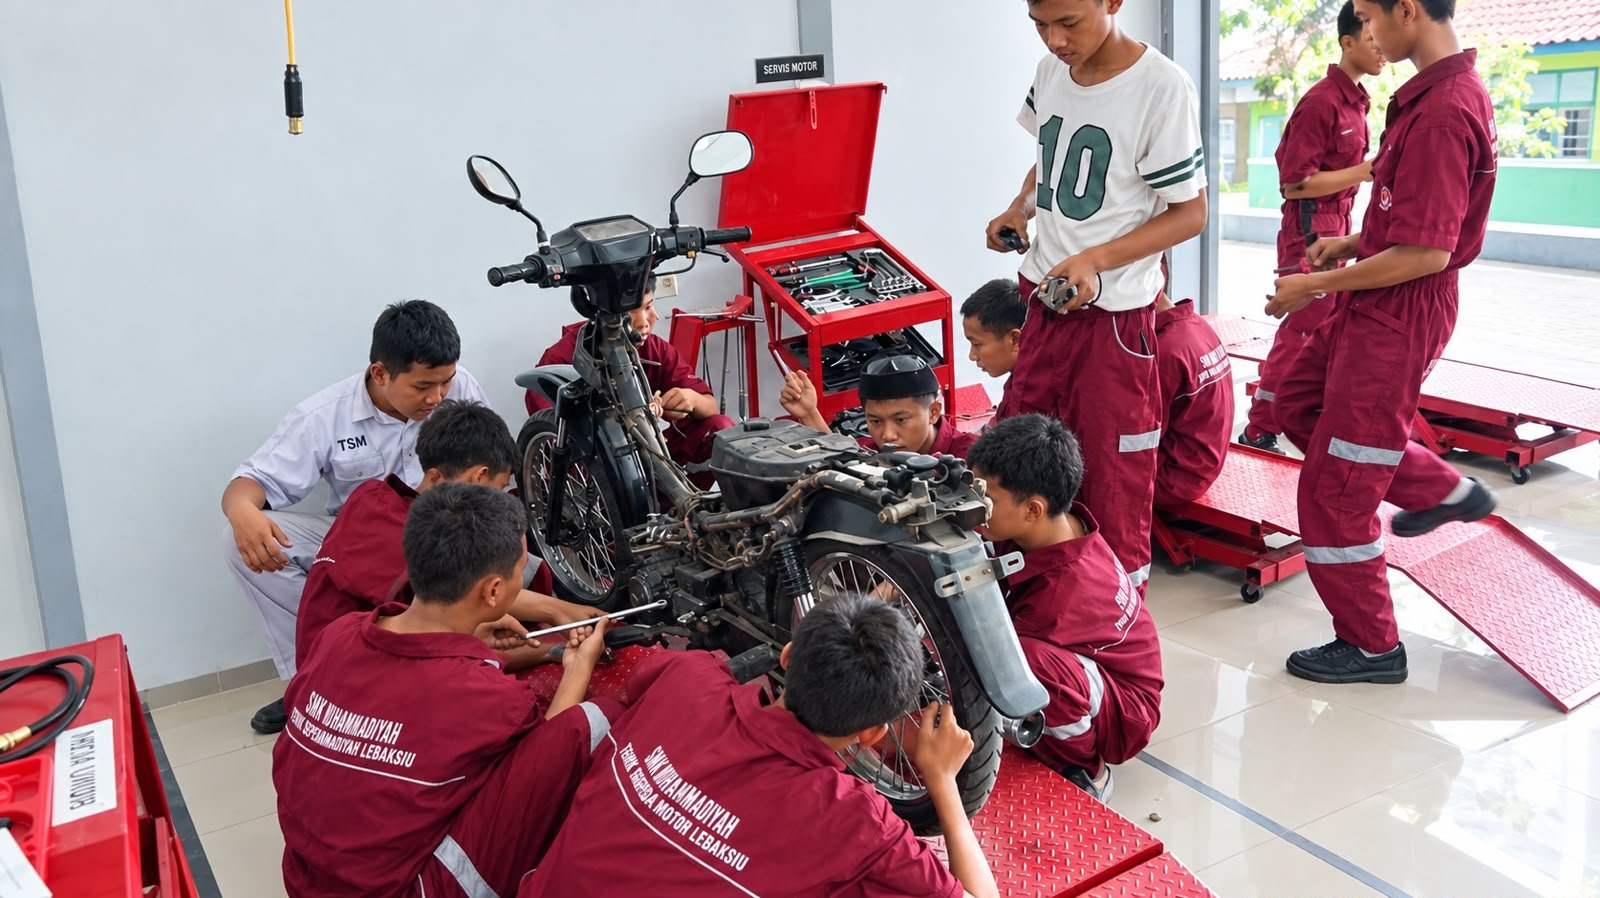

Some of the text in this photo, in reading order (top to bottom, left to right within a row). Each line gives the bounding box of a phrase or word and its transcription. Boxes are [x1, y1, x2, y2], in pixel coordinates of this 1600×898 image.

[763, 61, 818, 75] SERVIS MOTOR
[1037, 114, 1112, 221] 10
[337, 435, 367, 451] TSM
[305, 690, 327, 721] SMK
[360, 743, 416, 768] LEBAKSIU
[644, 745, 669, 777] SMK
[652, 799, 693, 836] MOTOR
[688, 826, 750, 872] LEBAKSIU
